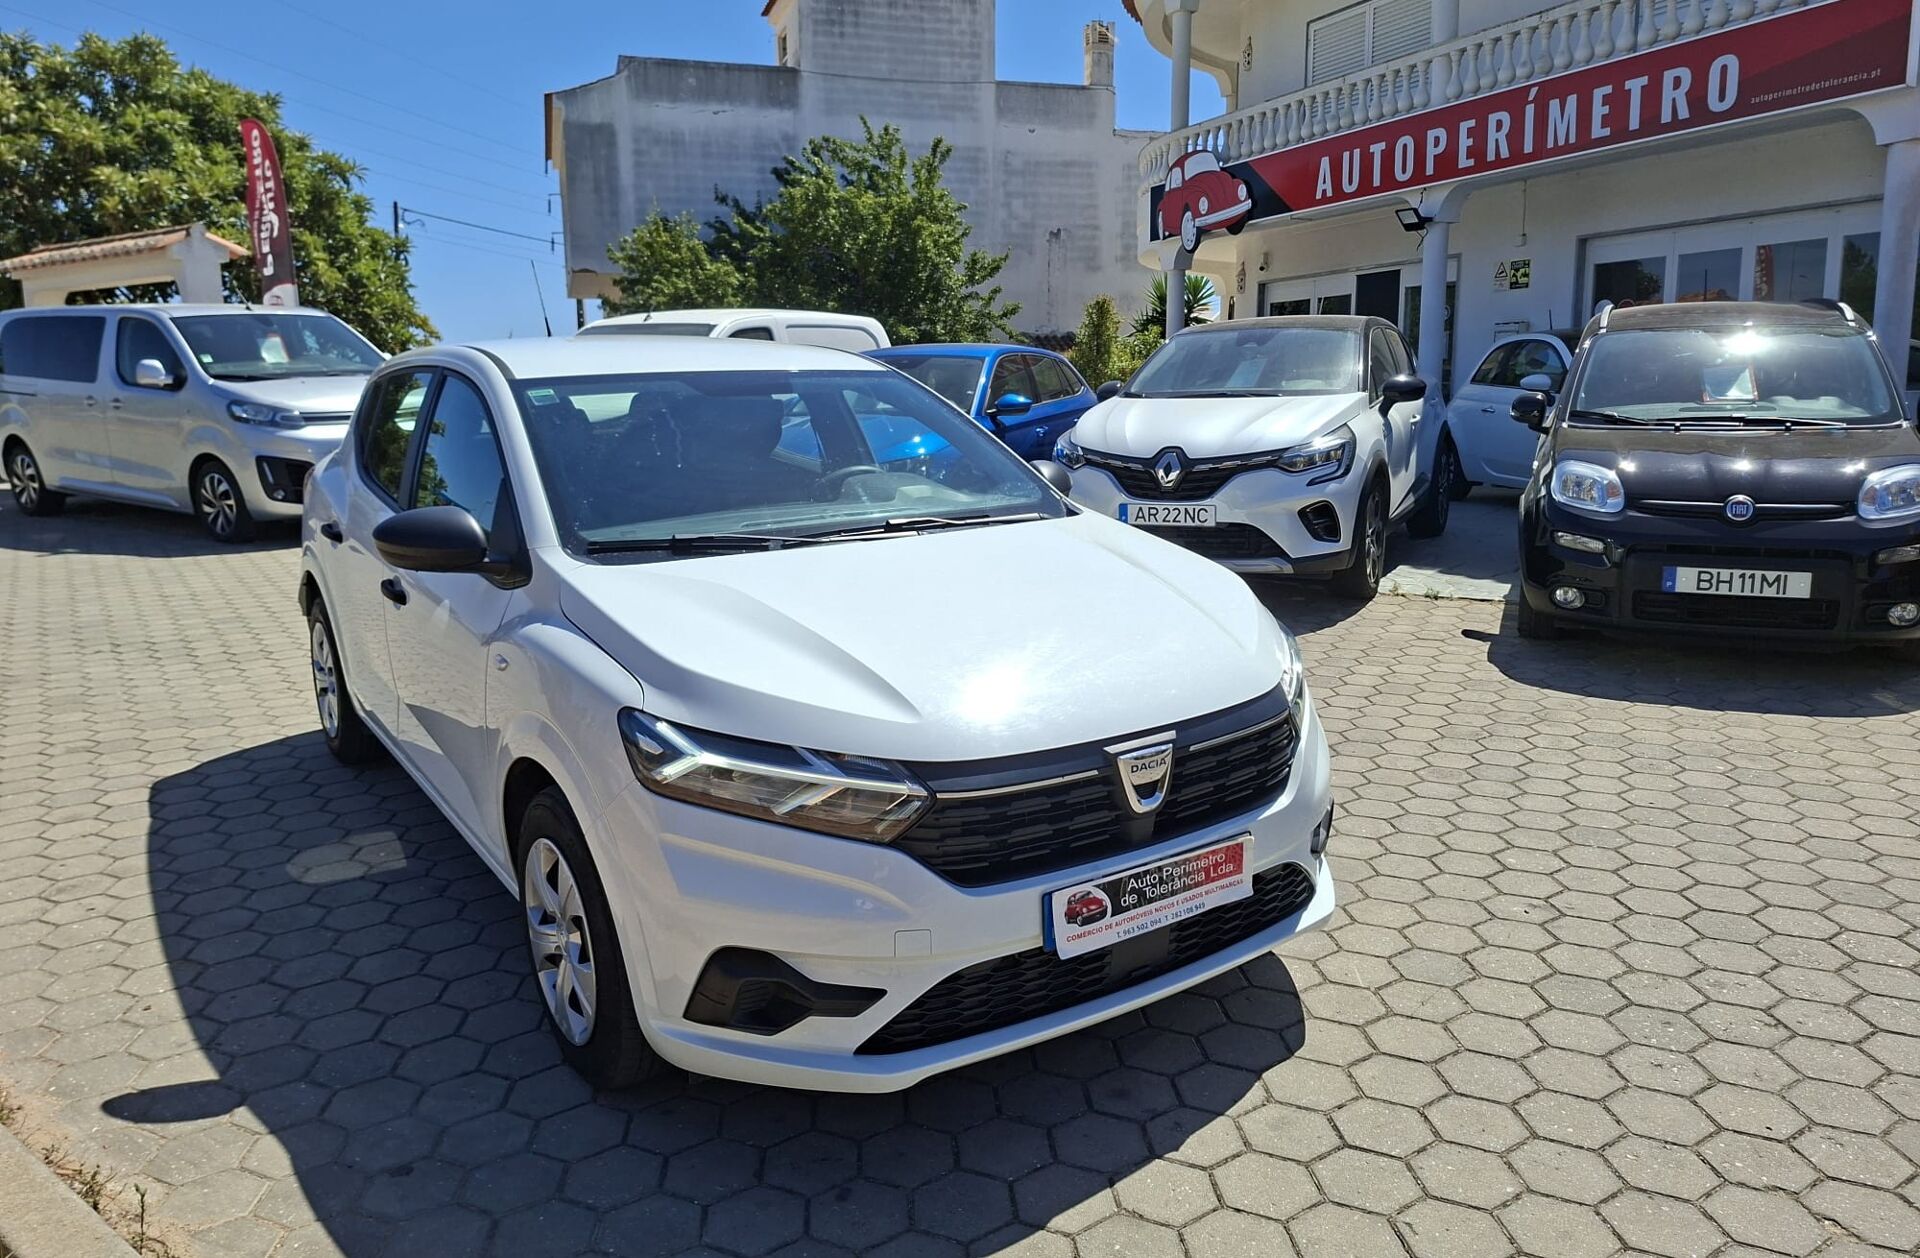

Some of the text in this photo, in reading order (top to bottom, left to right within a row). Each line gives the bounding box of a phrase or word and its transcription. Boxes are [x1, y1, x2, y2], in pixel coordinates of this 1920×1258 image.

[1750, 68, 1881, 104] autoperimetrodetolerancia.pt
[1315, 53, 1740, 199] AUTOPERÍMETRO
[1732, 505, 1748, 515] FIAT
[1131, 758, 1166, 773] DACIA
[1121, 862, 1237, 907] de Tolerância Lda.
[1127, 873, 1159, 891] Auto
[1105, 923, 1113, 931] DE
[1115, 910, 1153, 928] AUTOMÓVEIS
[1154, 902, 1175, 913] NOVOS
[1181, 892, 1203, 904] USADOS
[1204, 878, 1243, 896] MULTIMARCAS
[1123, 926, 1135, 936] 963
[1136, 921, 1149, 931] 502
[1150, 917, 1162, 927] 094
